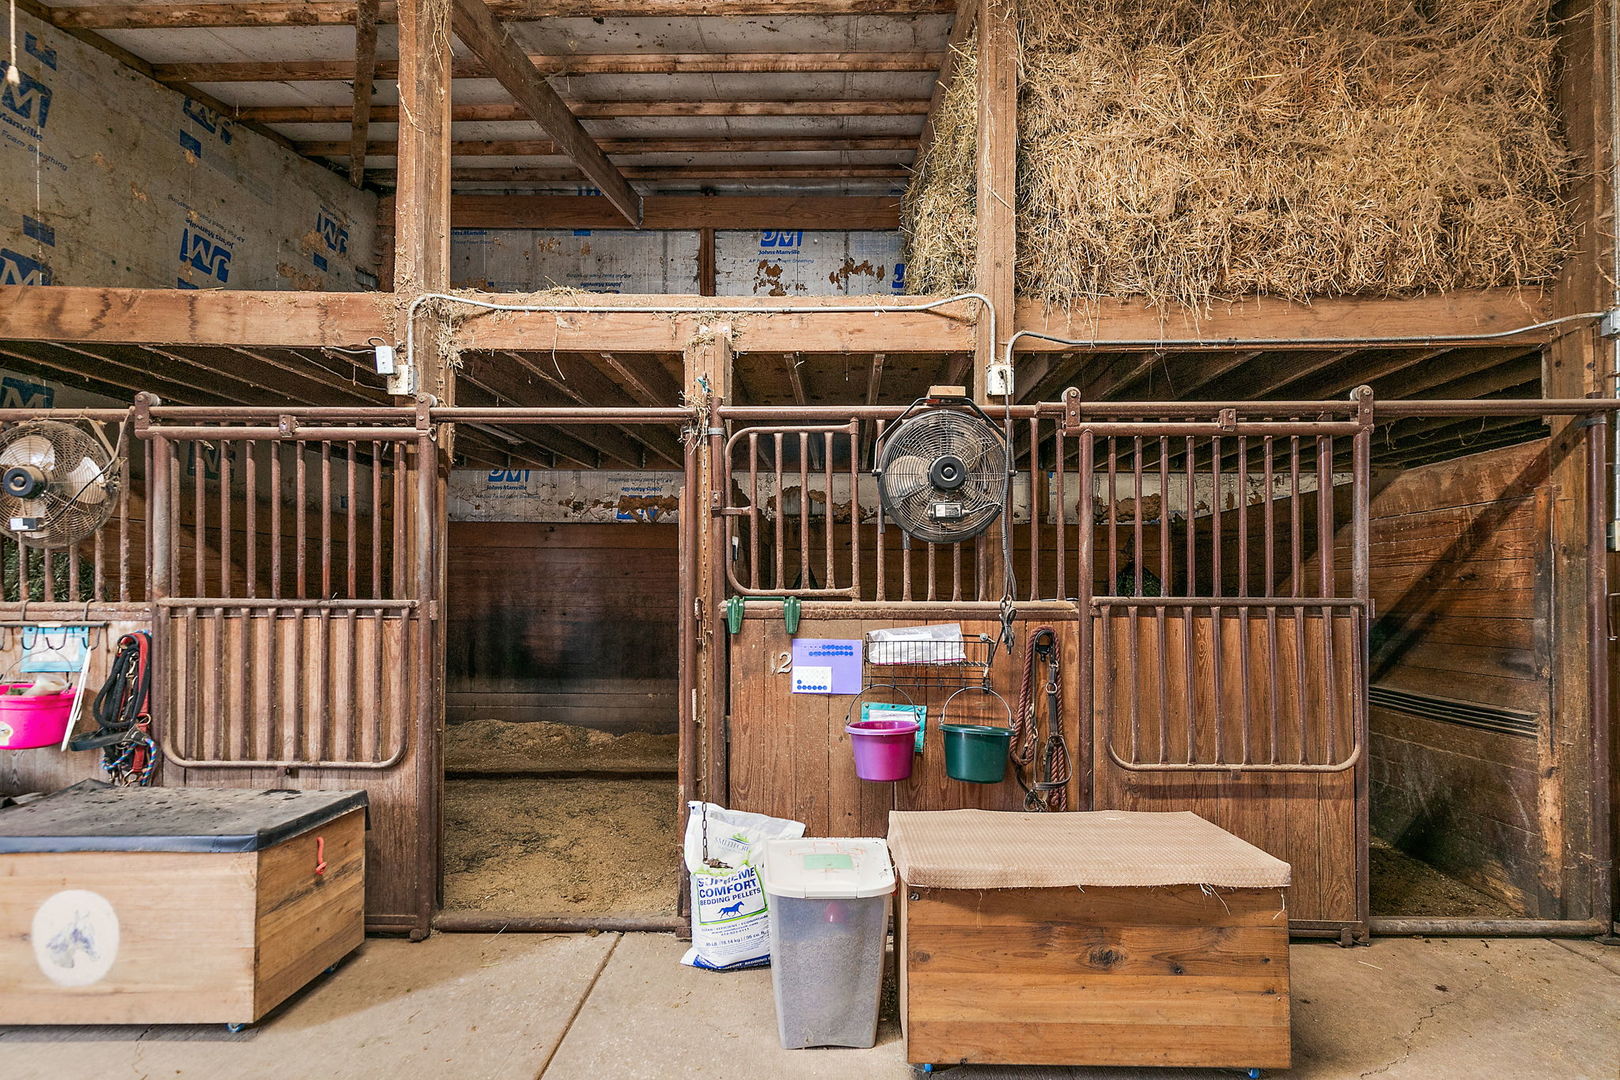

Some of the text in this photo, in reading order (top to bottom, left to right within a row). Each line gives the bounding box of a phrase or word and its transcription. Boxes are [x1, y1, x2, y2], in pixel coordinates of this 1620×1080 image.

[179, 228, 233, 284] JM
[699, 878, 757, 899] COMFORT
[700, 887, 762, 906] BEDDING PELLETS
